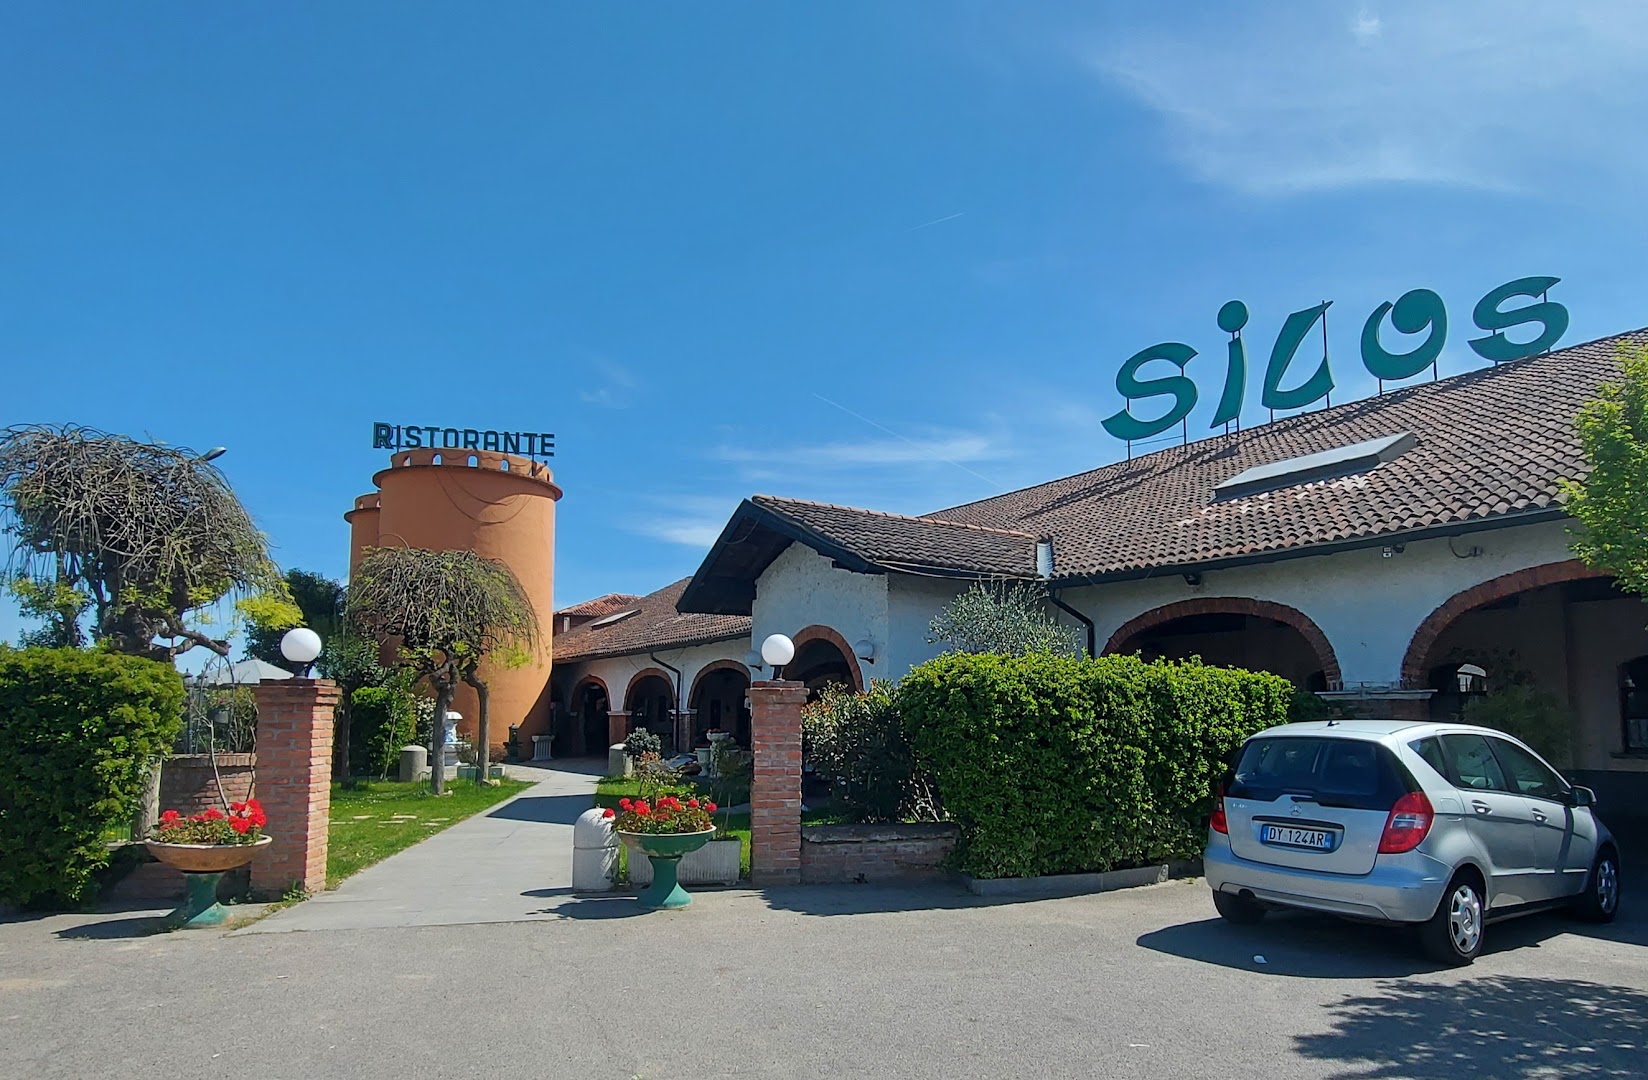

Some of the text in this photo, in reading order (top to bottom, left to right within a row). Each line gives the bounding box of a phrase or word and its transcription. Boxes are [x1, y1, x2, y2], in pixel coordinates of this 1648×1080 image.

[373, 421, 555, 457] RISTORANTE
[1269, 827, 1324, 846] DY 124AR
